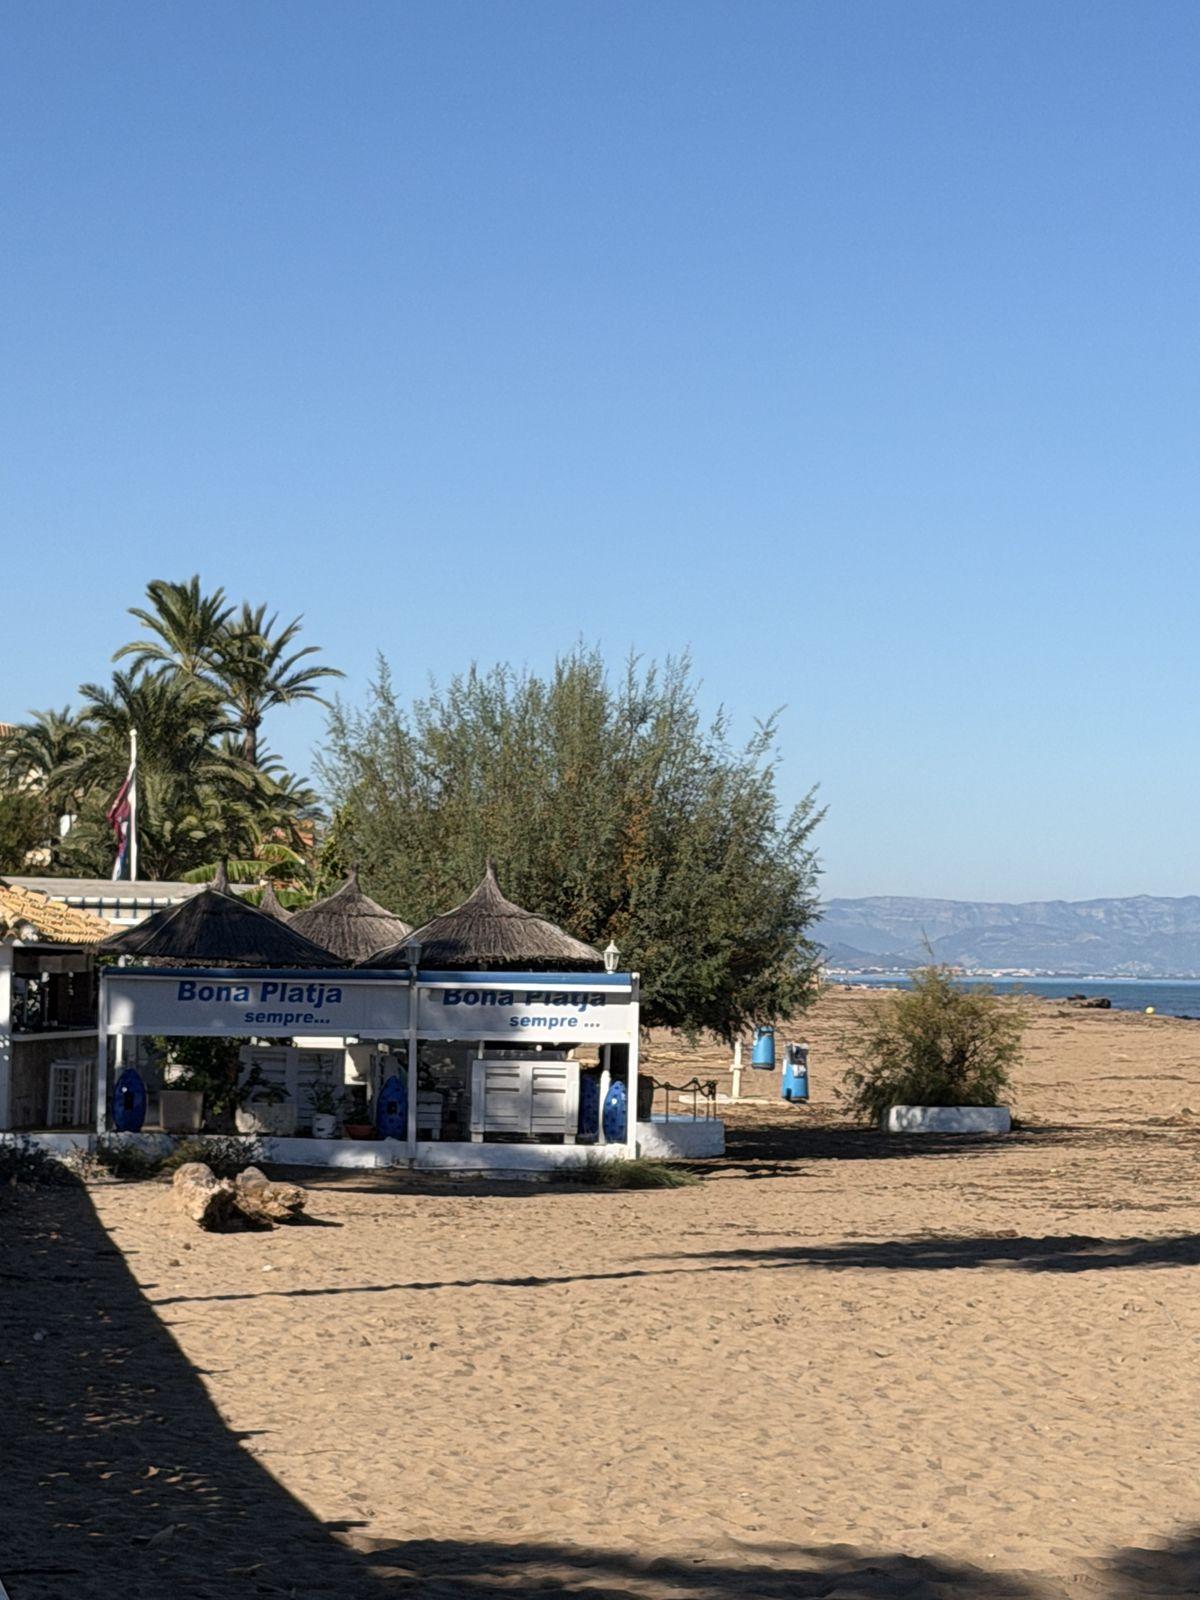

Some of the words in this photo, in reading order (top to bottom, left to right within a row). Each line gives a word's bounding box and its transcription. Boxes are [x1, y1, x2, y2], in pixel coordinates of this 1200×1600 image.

[177, 980, 250, 1002] Bona
[260, 981, 342, 1009] Platja
[442, 988, 514, 1006] Bona
[525, 988, 606, 1012] Platja
[244, 1011, 331, 1026] sempre...
[509, 1015, 578, 1030] sempre
